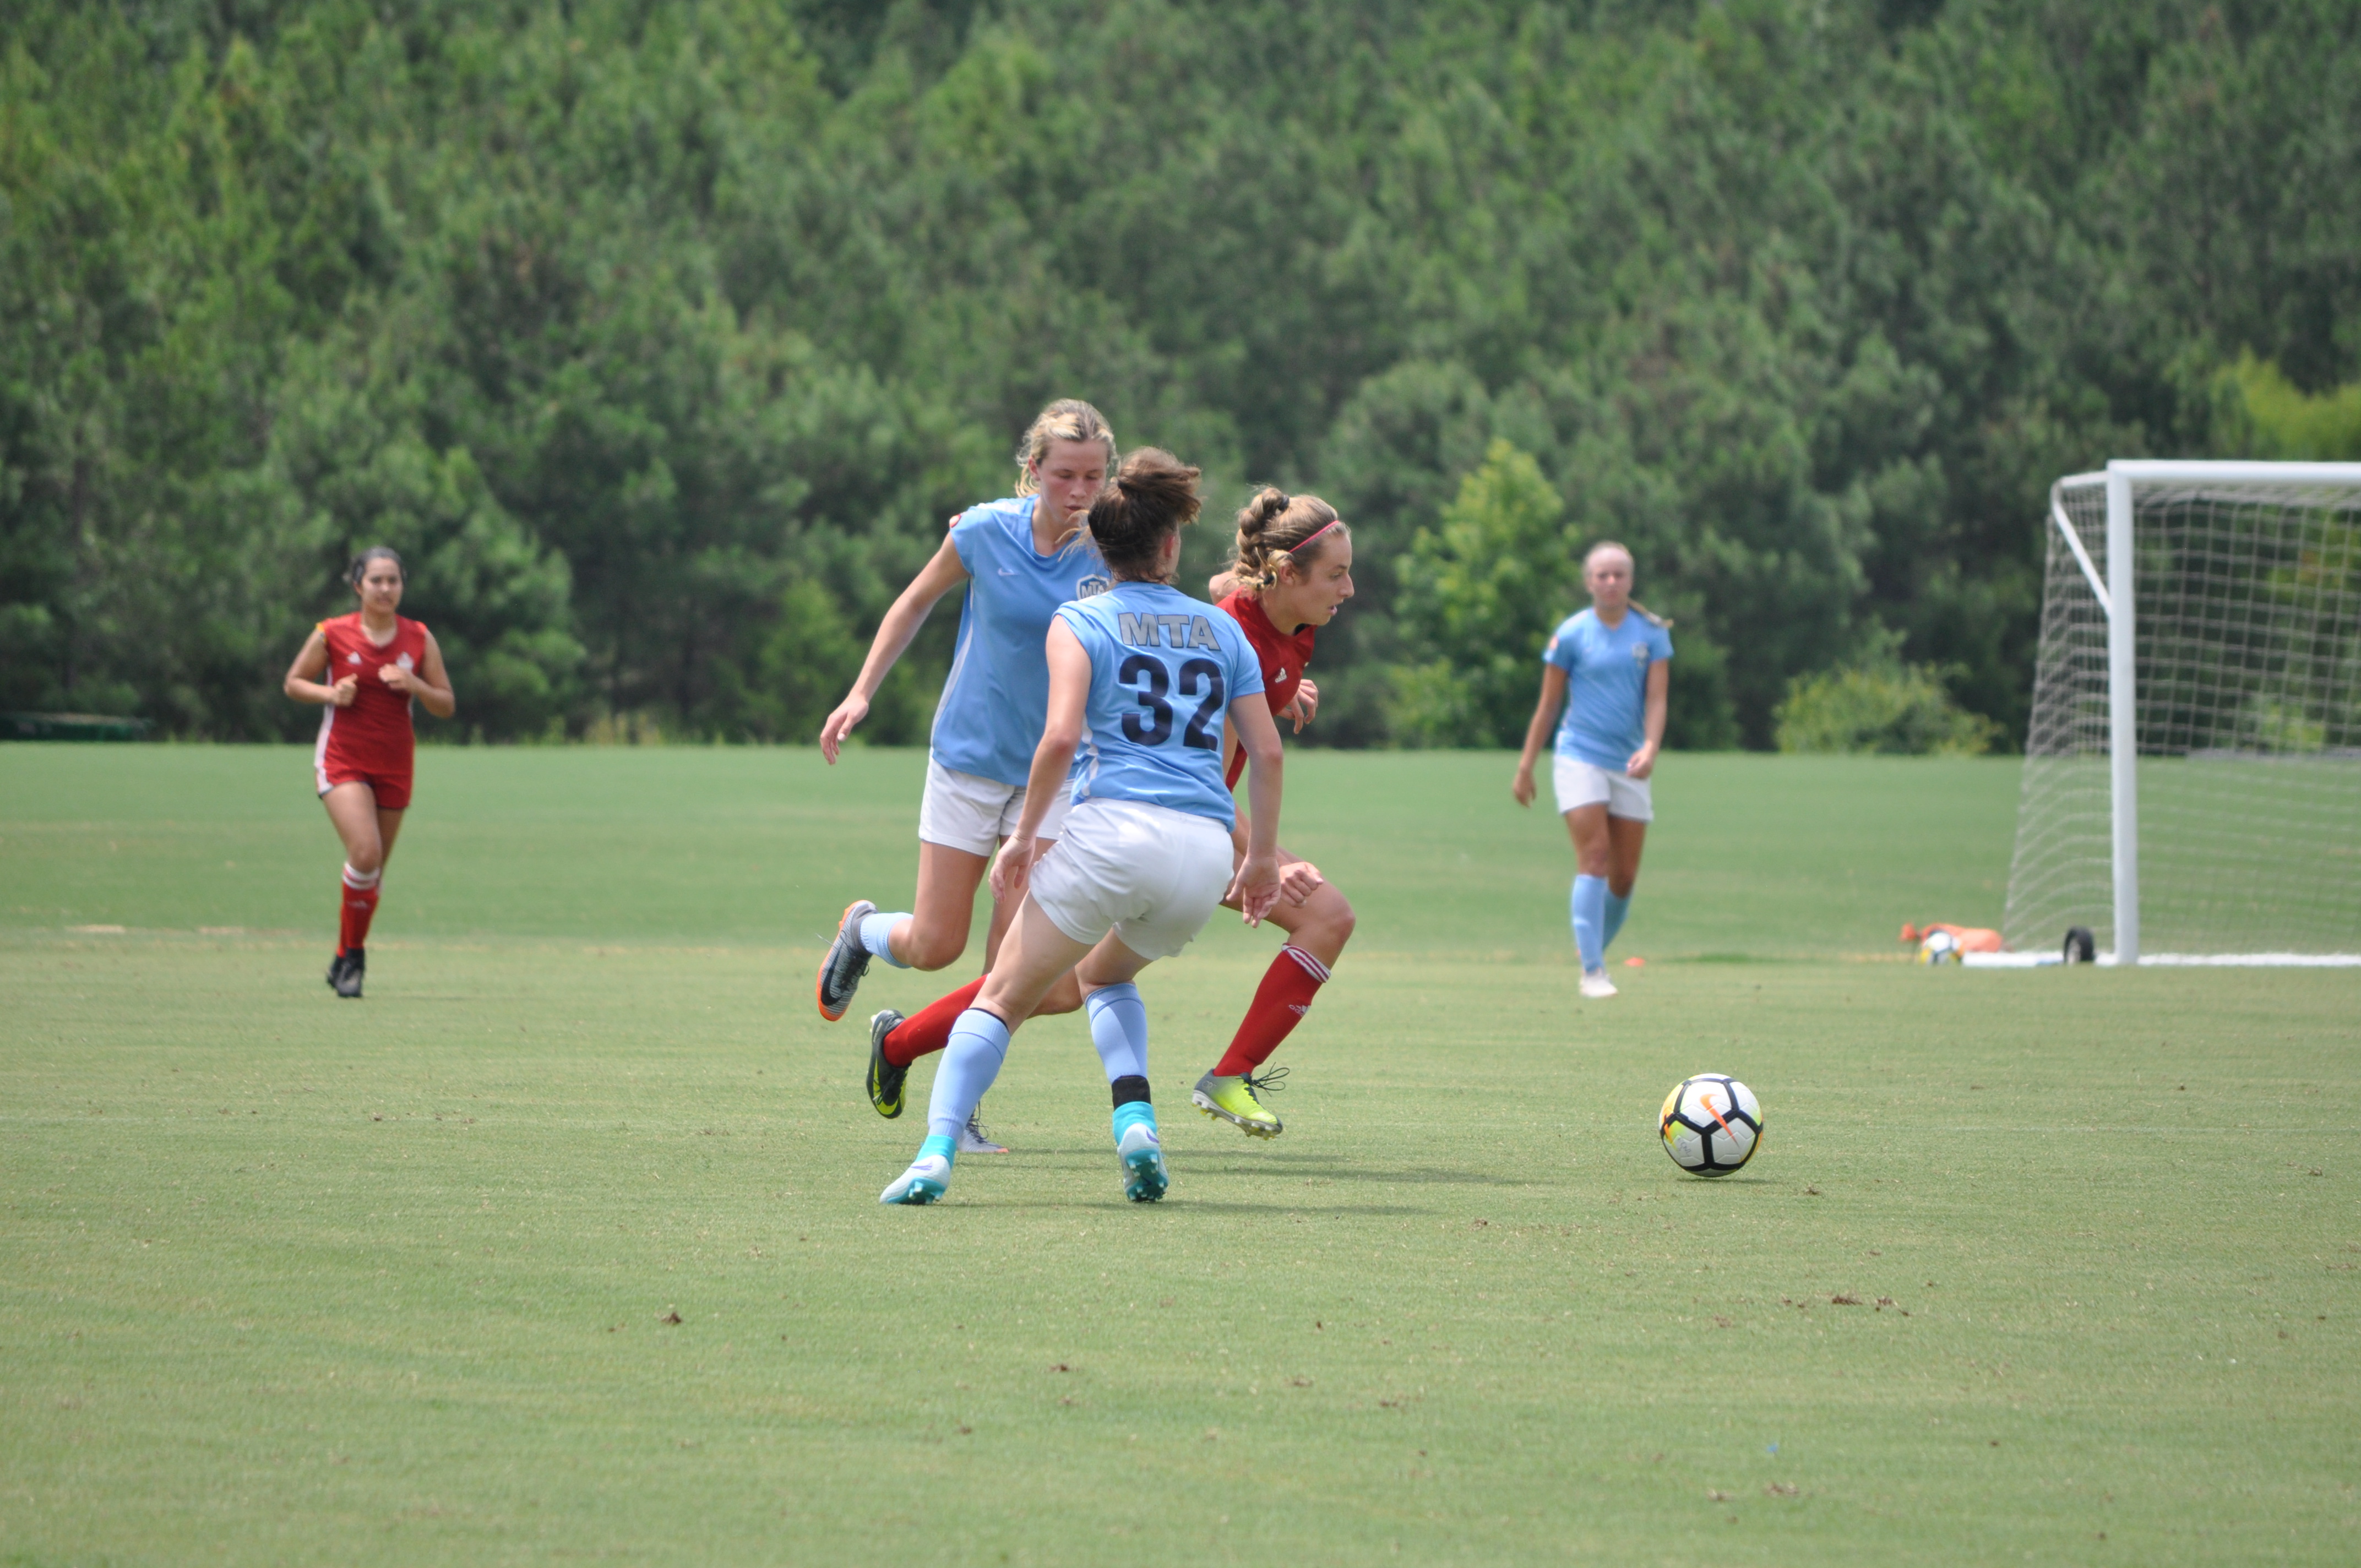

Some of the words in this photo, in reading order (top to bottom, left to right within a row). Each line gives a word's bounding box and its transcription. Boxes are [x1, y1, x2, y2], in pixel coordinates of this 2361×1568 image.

[1081, 581, 1105, 599] MTA
[1118, 612, 1221, 651] MTA
[1119, 654, 1224, 751] 32
